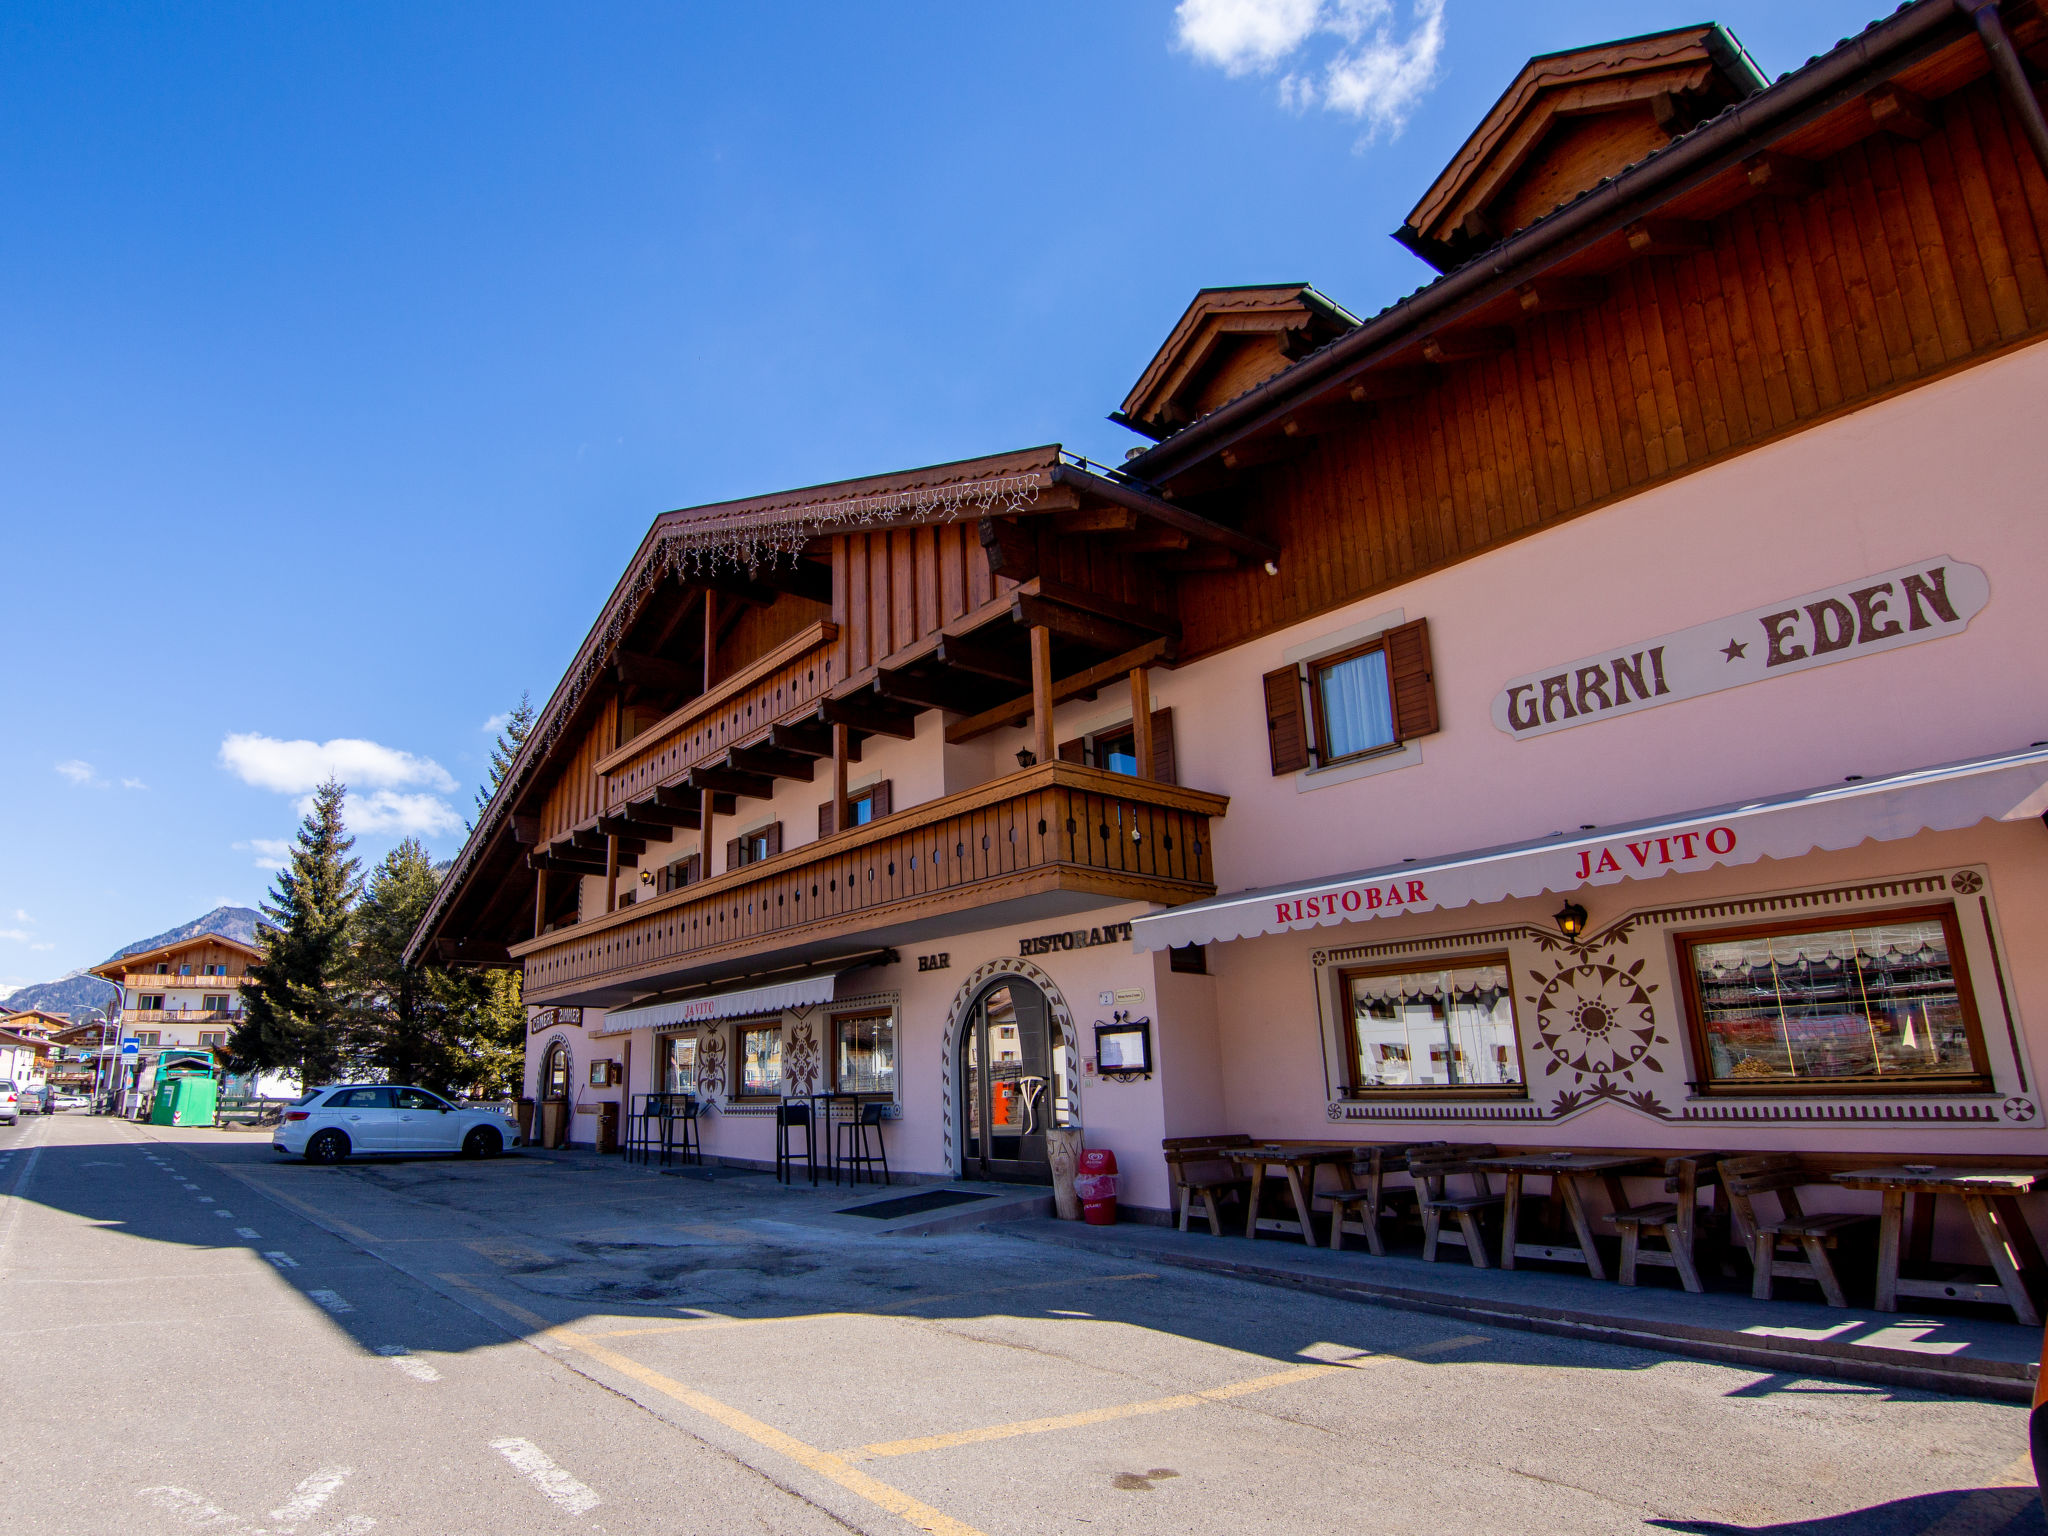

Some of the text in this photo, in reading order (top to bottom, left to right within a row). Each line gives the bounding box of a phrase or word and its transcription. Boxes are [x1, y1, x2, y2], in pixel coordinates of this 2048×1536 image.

[1506, 566, 1960, 732] GARNI EDEN
[1275, 827, 1737, 924] RISTOBAR JAVITO
[1018, 921, 1133, 957] RISTORANT
[918, 952, 951, 972] BAR
[533, 1007, 581, 1032] CAMERE ZIMMER
[685, 1000, 714, 1019] JAVITO
